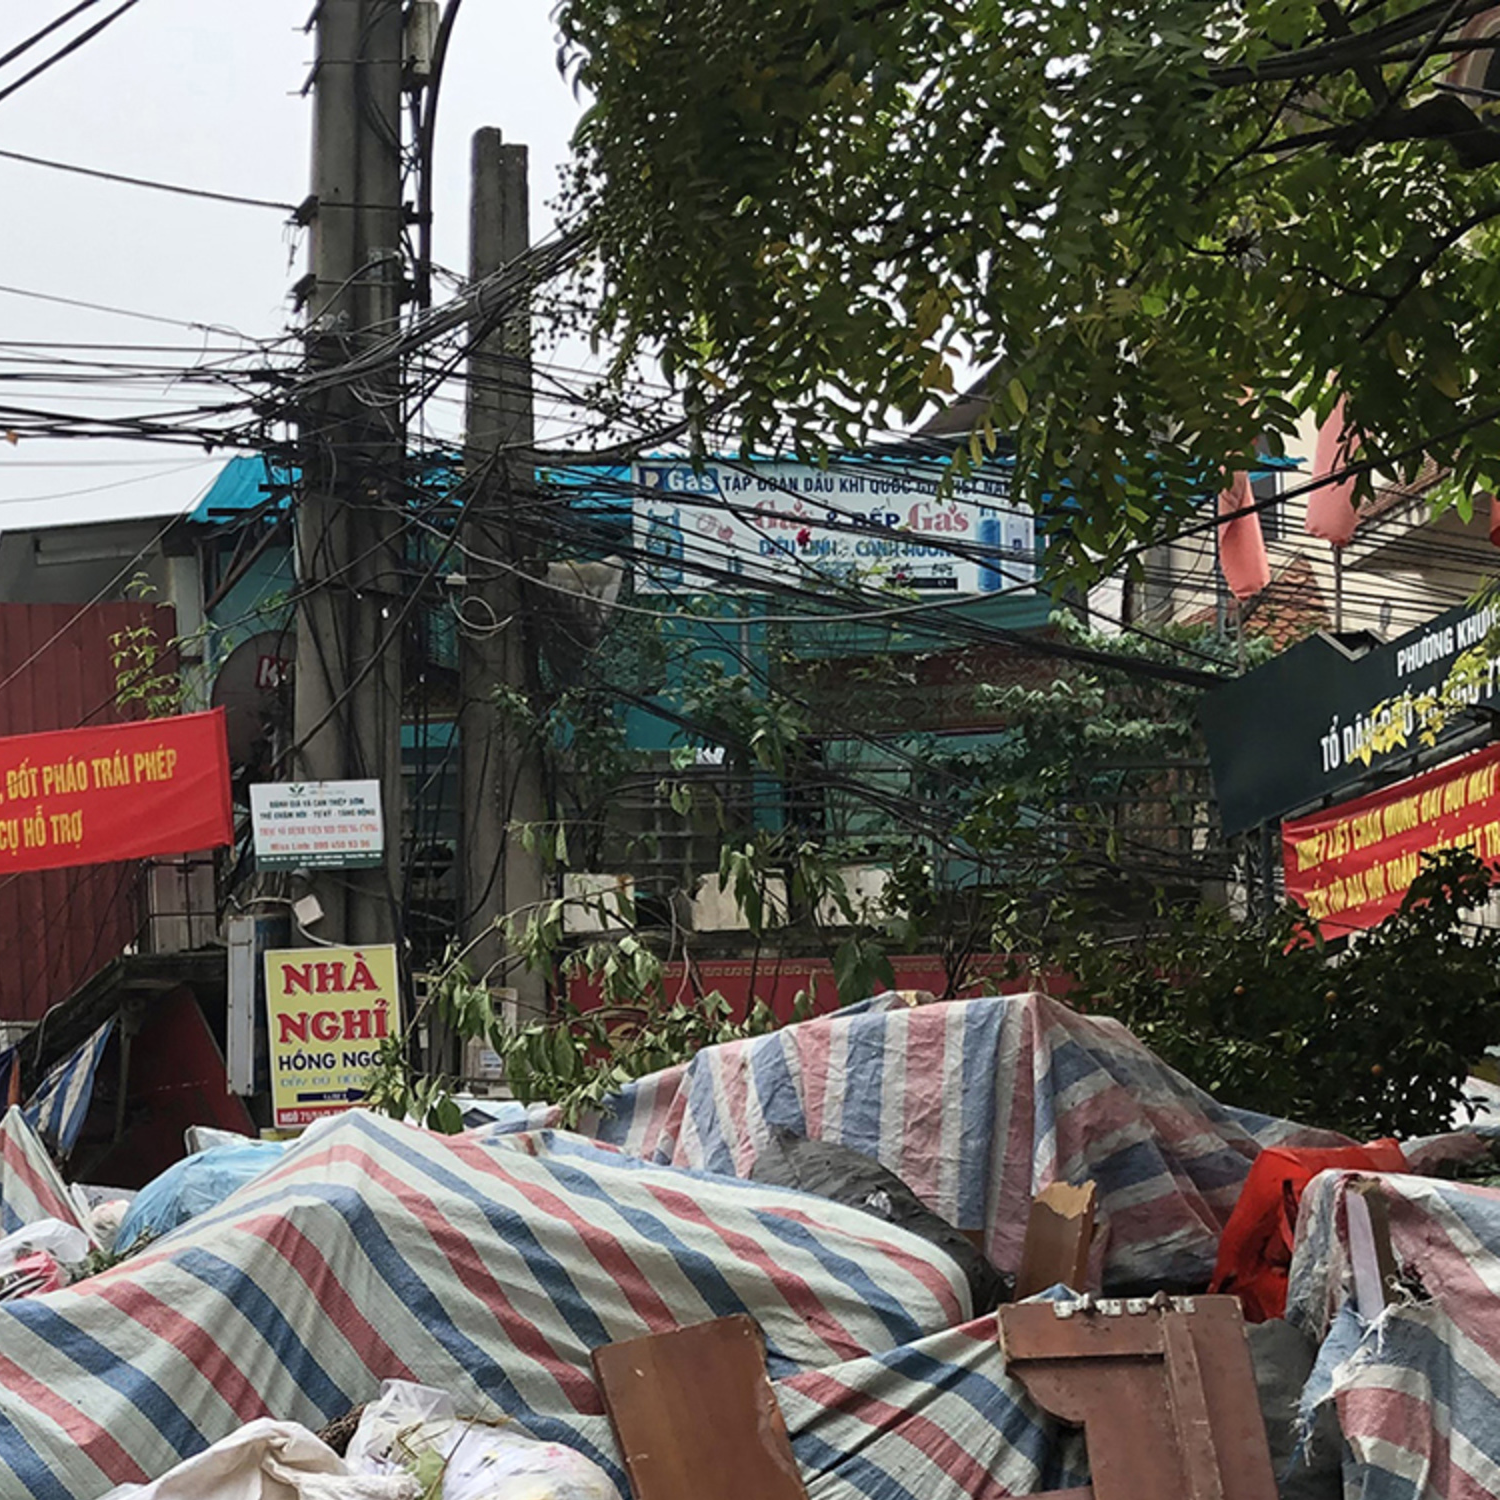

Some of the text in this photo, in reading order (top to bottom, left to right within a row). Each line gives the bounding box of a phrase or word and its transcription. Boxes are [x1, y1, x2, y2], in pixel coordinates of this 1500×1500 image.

[667, 470, 716, 491] Gas
[722, 472, 751, 495] TẬP
[803, 472, 835, 493] DẦU
[908, 501, 969, 532] Gas
[1397, 627, 1454, 678] PHƯỜNG
[7, 757, 39, 801] ĐỐT
[43, 757, 88, 795] PHÁO
[91, 752, 131, 789] TRÁI
[135, 747, 178, 786] PHÉP
[23, 804, 46, 848] HỖ
[50, 808, 83, 848] TRỢ
[281, 952, 379, 994] NHÀ
[277, 998, 389, 1043] NGHỈ
